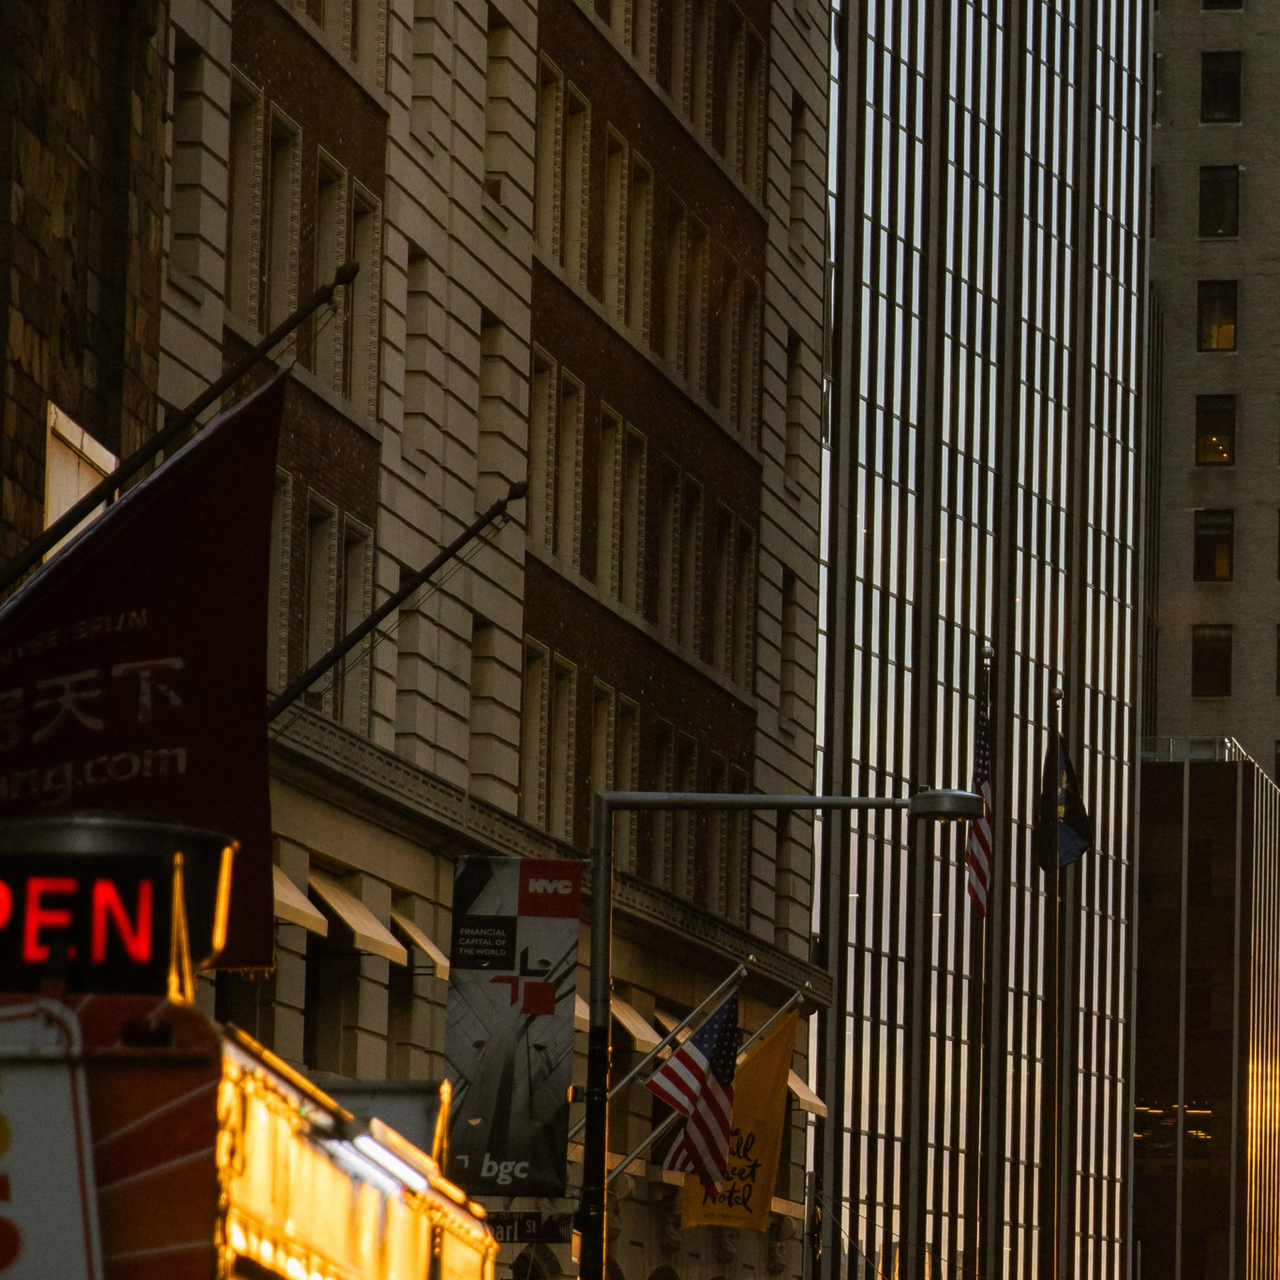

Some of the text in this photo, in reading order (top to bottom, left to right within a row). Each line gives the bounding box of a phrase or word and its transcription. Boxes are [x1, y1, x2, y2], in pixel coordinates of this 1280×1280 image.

[528, 878, 573, 894] NYC
[460, 927, 506, 937] FINANCIAL
[459, 938, 493, 946] CAPITAL
[476, 948, 507, 956] WORLD
[728, 1132, 755, 1162] all
[481, 1153, 529, 1185] bgc
[490, 1219, 537, 1241] arl St
